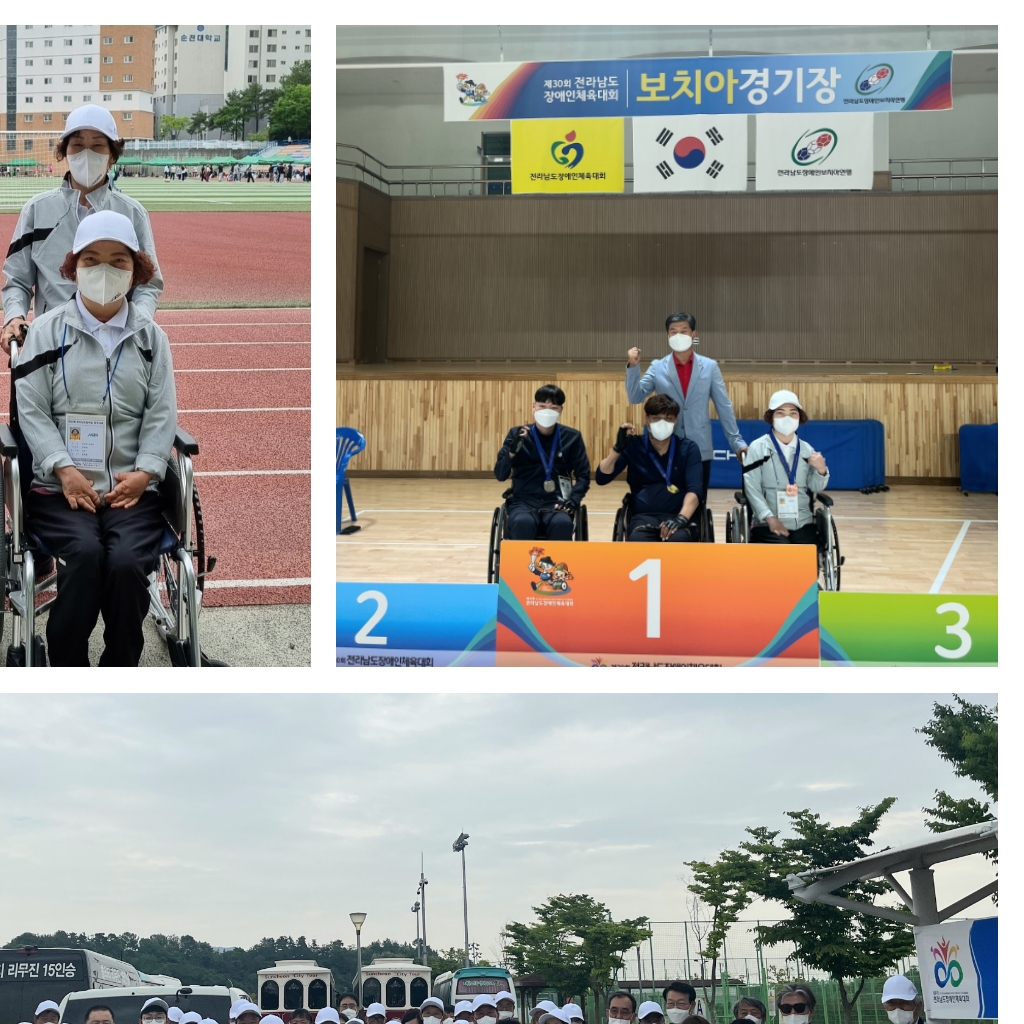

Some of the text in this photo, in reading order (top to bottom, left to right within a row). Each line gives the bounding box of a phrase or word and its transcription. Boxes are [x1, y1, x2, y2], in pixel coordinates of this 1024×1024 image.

[181, 34, 221, 42] 순천대학교
[543, 76, 619, 89] 제30회 전라남도
[636, 67, 842, 105] 보치아경기장
[543, 89, 619, 103] 장애인체육대회
[529, 171, 607, 181] 전라남도장애인체육대회
[628, 558, 661, 639] 1
[354, 590, 389, 645] 2
[934, 602, 973, 659] 3
[347, 655, 433, 667] 전라남도장애인체육대회
[7, 962, 39, 978] 리무진
[42, 963, 77, 978] 15인승
